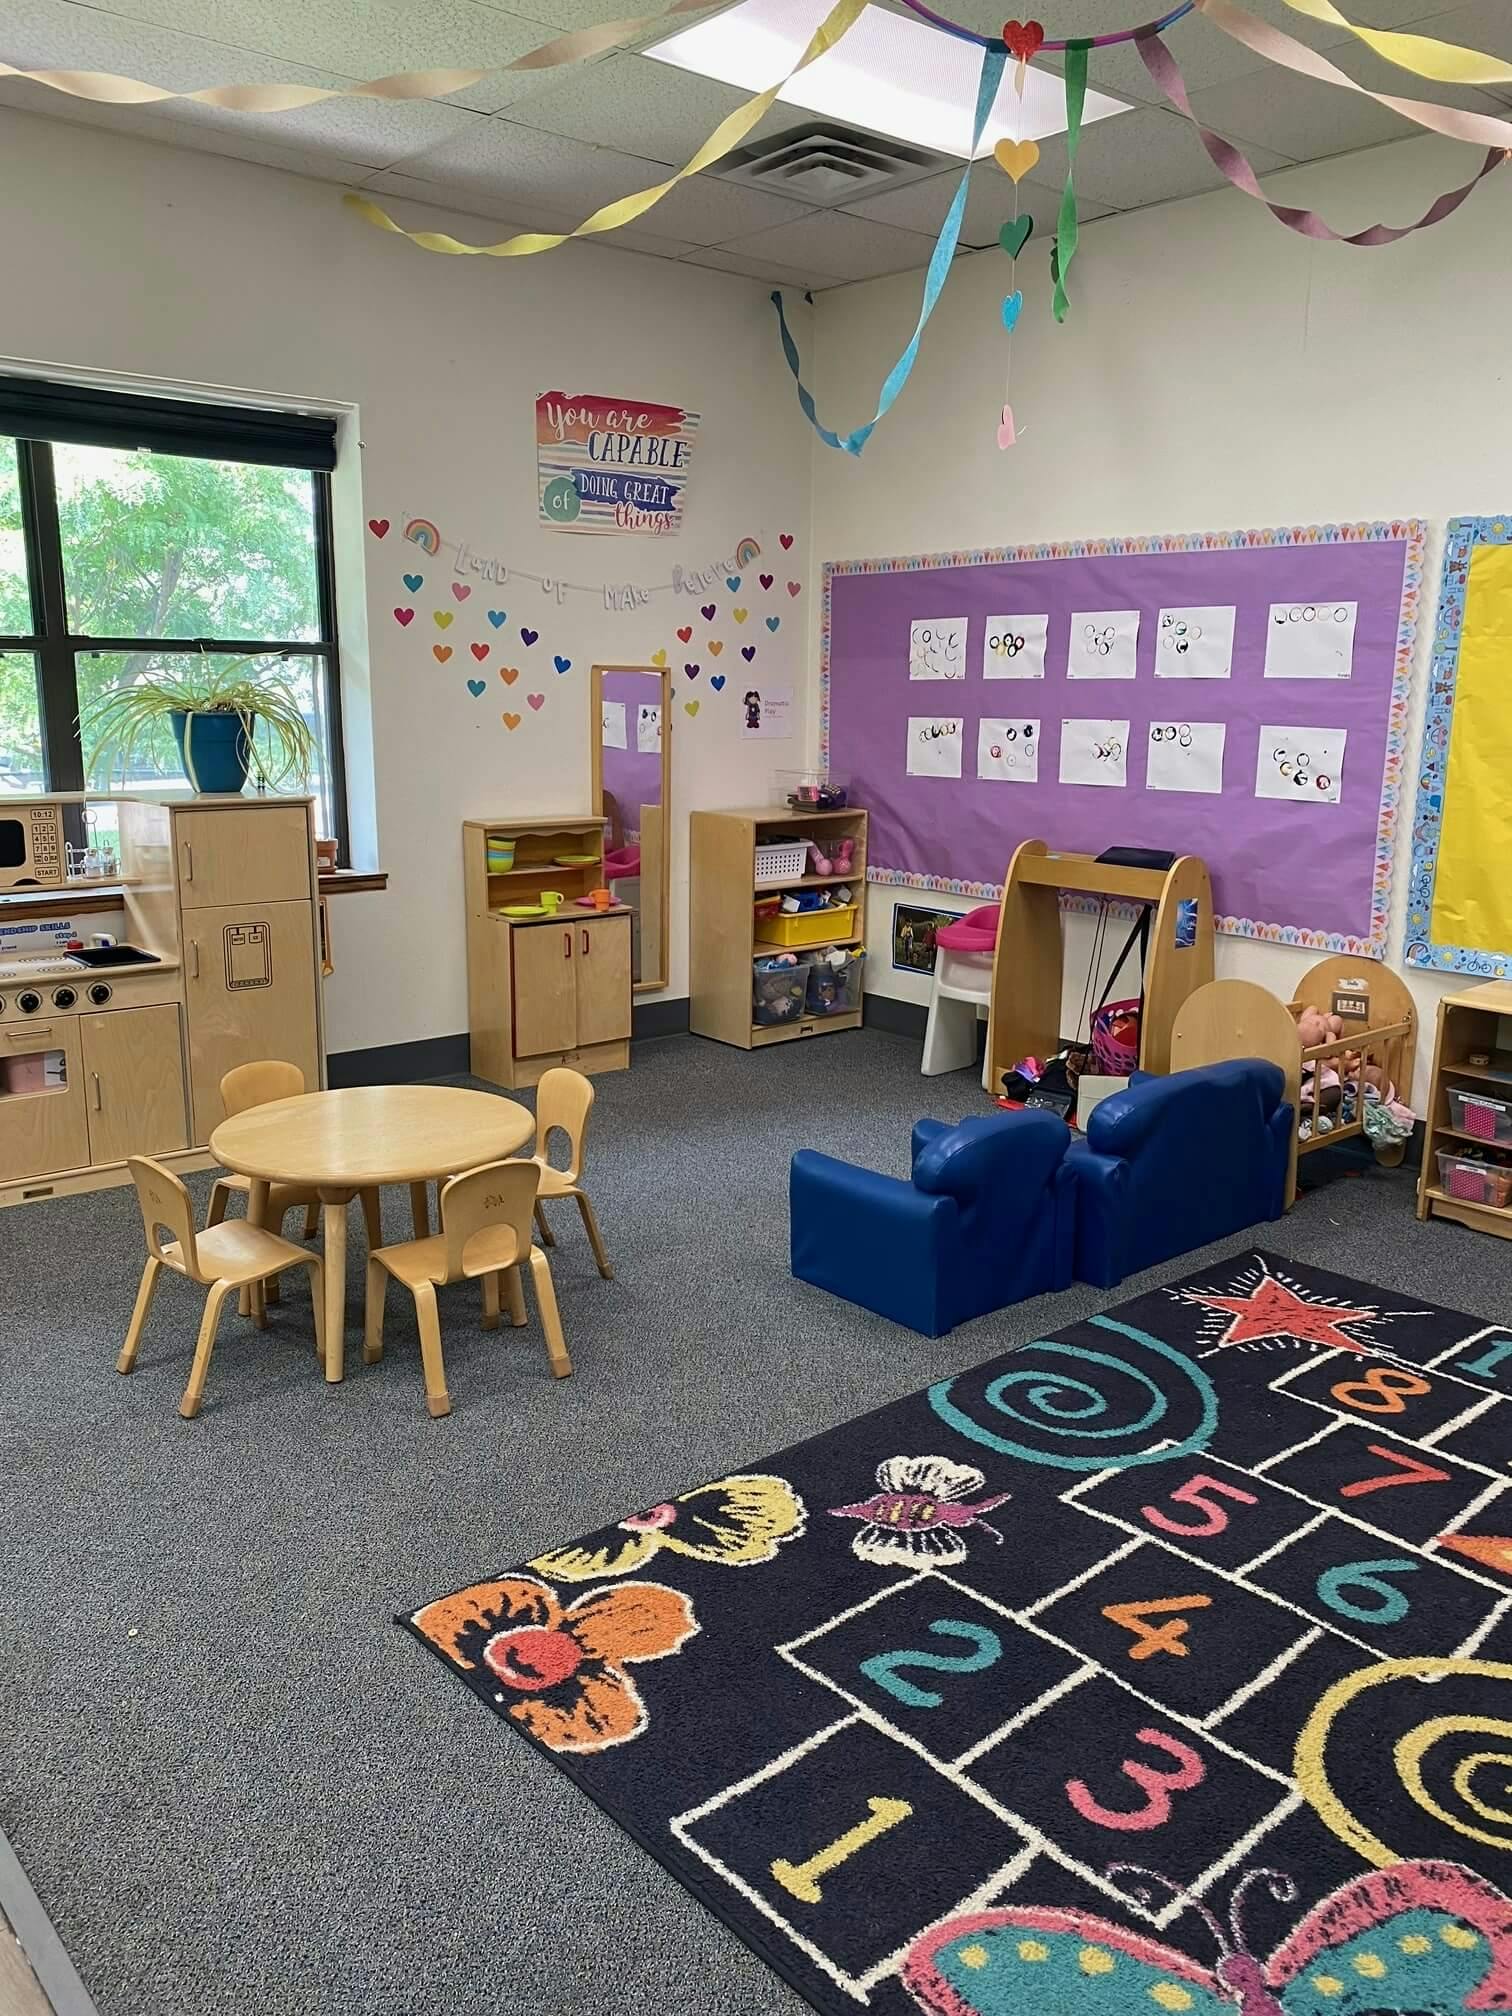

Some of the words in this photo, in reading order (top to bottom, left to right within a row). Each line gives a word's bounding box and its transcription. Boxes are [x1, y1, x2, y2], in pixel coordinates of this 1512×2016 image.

[546, 402, 599, 440] You
[606, 409, 652, 433] are
[588, 431, 688, 468] CAPABLE
[552, 489, 571, 511] of
[580, 473, 618, 499] DOING
[624, 480, 669, 505] GREAT
[1330, 1367, 1432, 1414] 8
[1339, 1445, 1452, 1498] 7
[1141, 1474, 1258, 1537] 5
[1316, 1558, 1418, 1625] 6
[1102, 1593, 1213, 1660] 4
[858, 1618, 1004, 1708] 2
[1064, 1727, 1206, 1832] 3
[770, 1797, 912, 1904] 1
